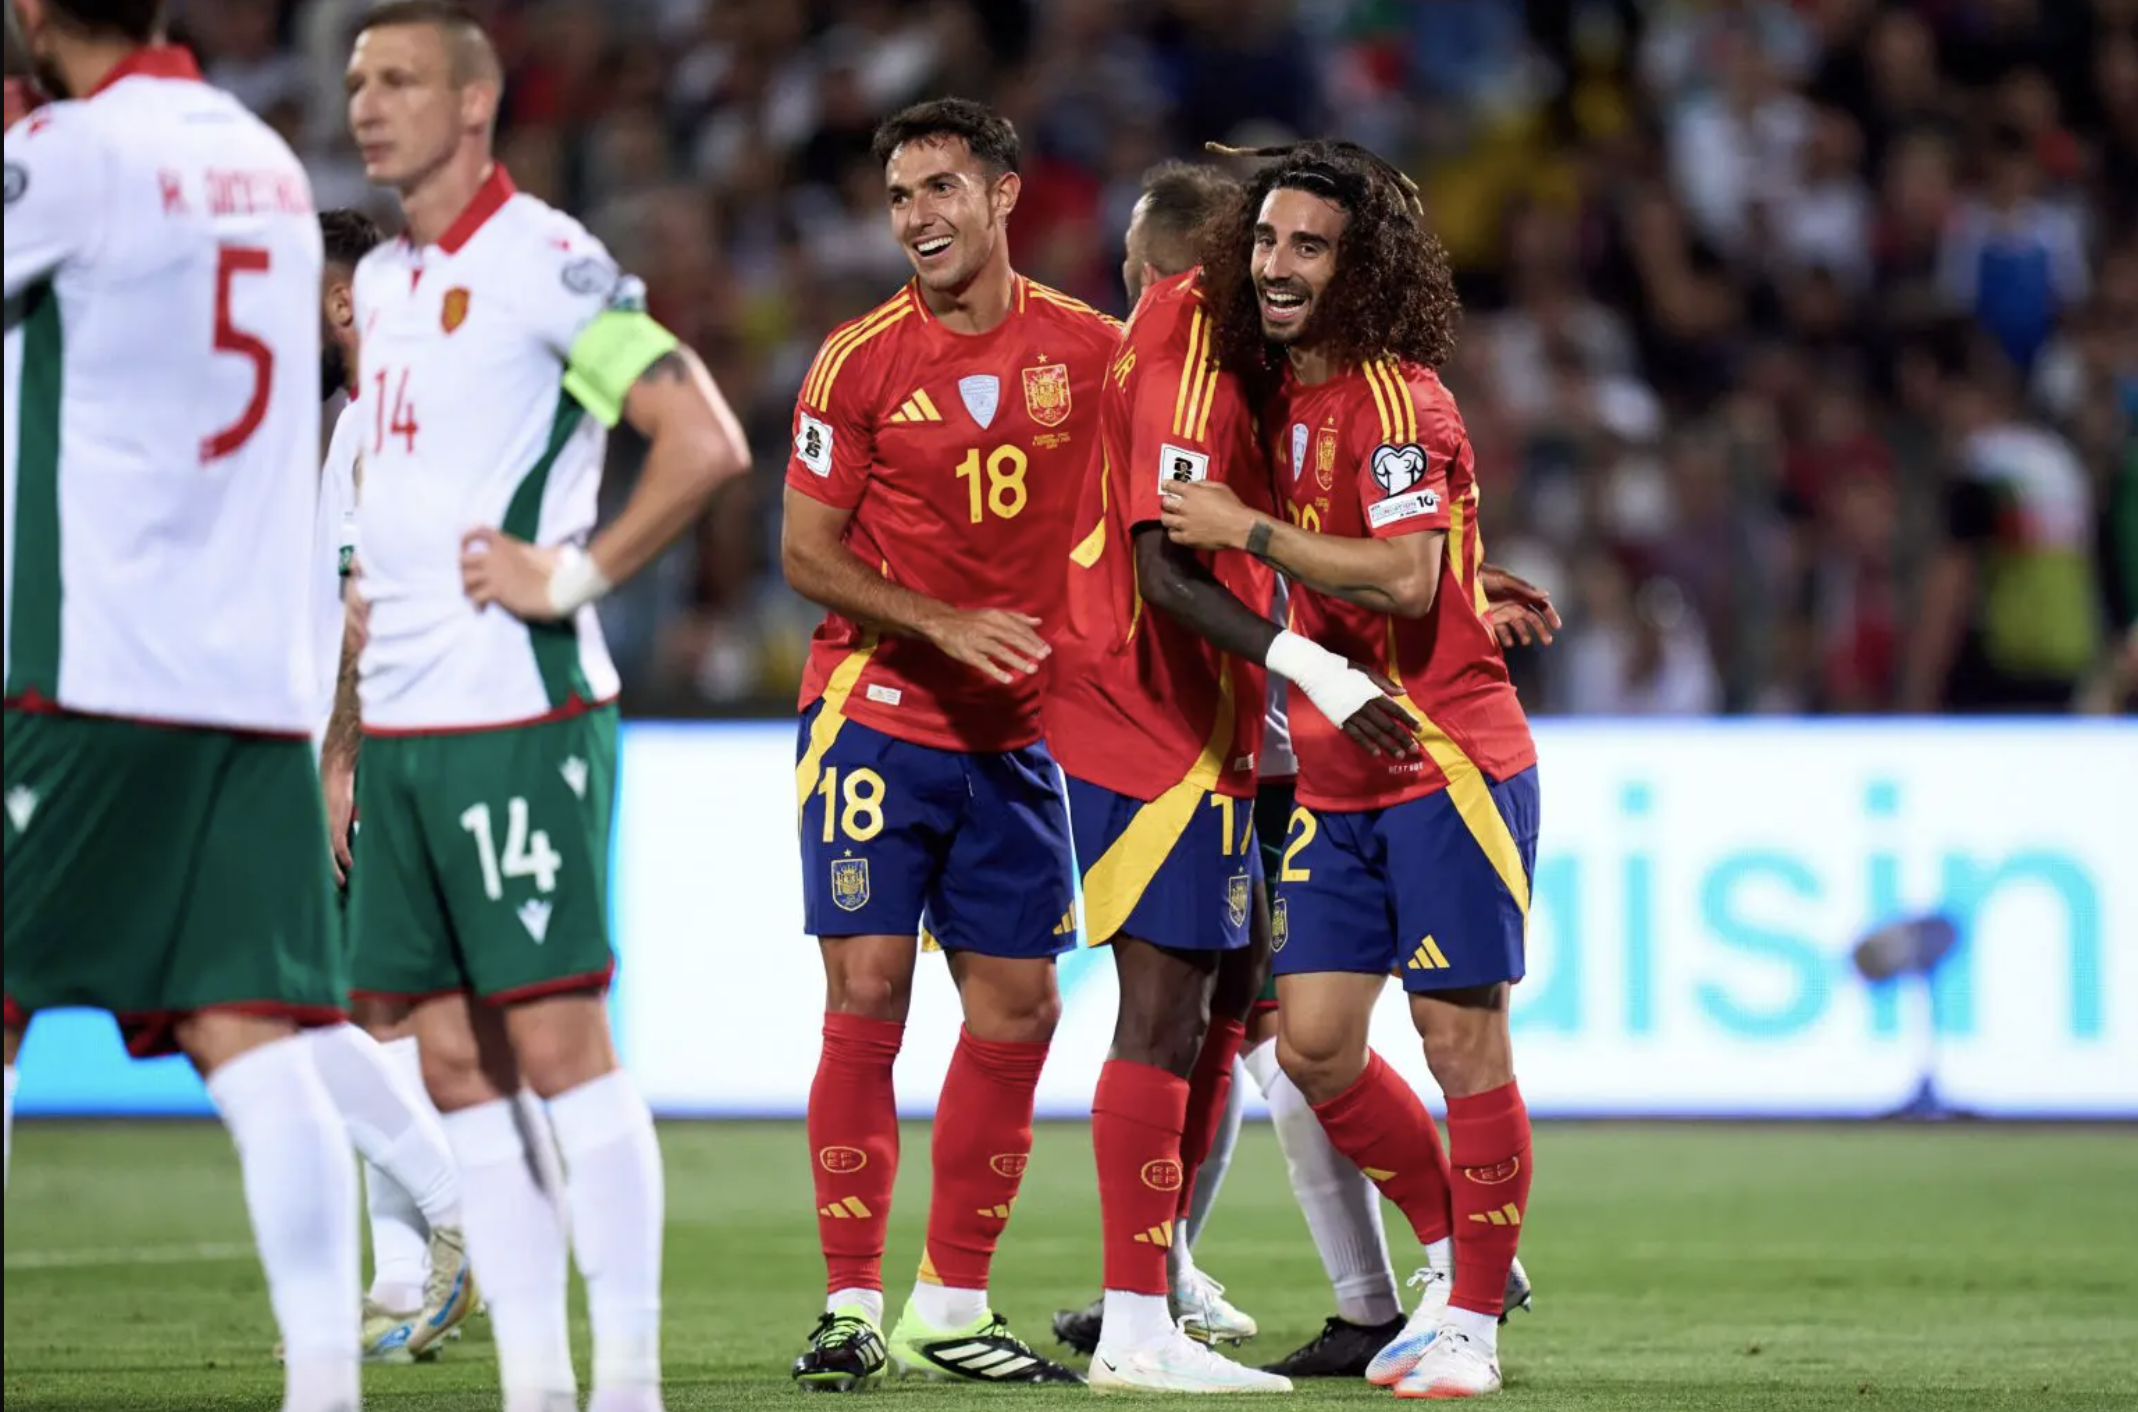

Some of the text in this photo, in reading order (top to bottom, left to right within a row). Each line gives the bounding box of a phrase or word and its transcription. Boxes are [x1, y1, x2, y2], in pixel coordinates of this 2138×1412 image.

[200, 246, 275, 466] 5
[374, 366, 419, 454] 14
[956, 444, 1028, 524] 18
[817, 766, 886, 842] 18
[1281, 806, 1317, 882] 2
[461, 797, 561, 901] 14
